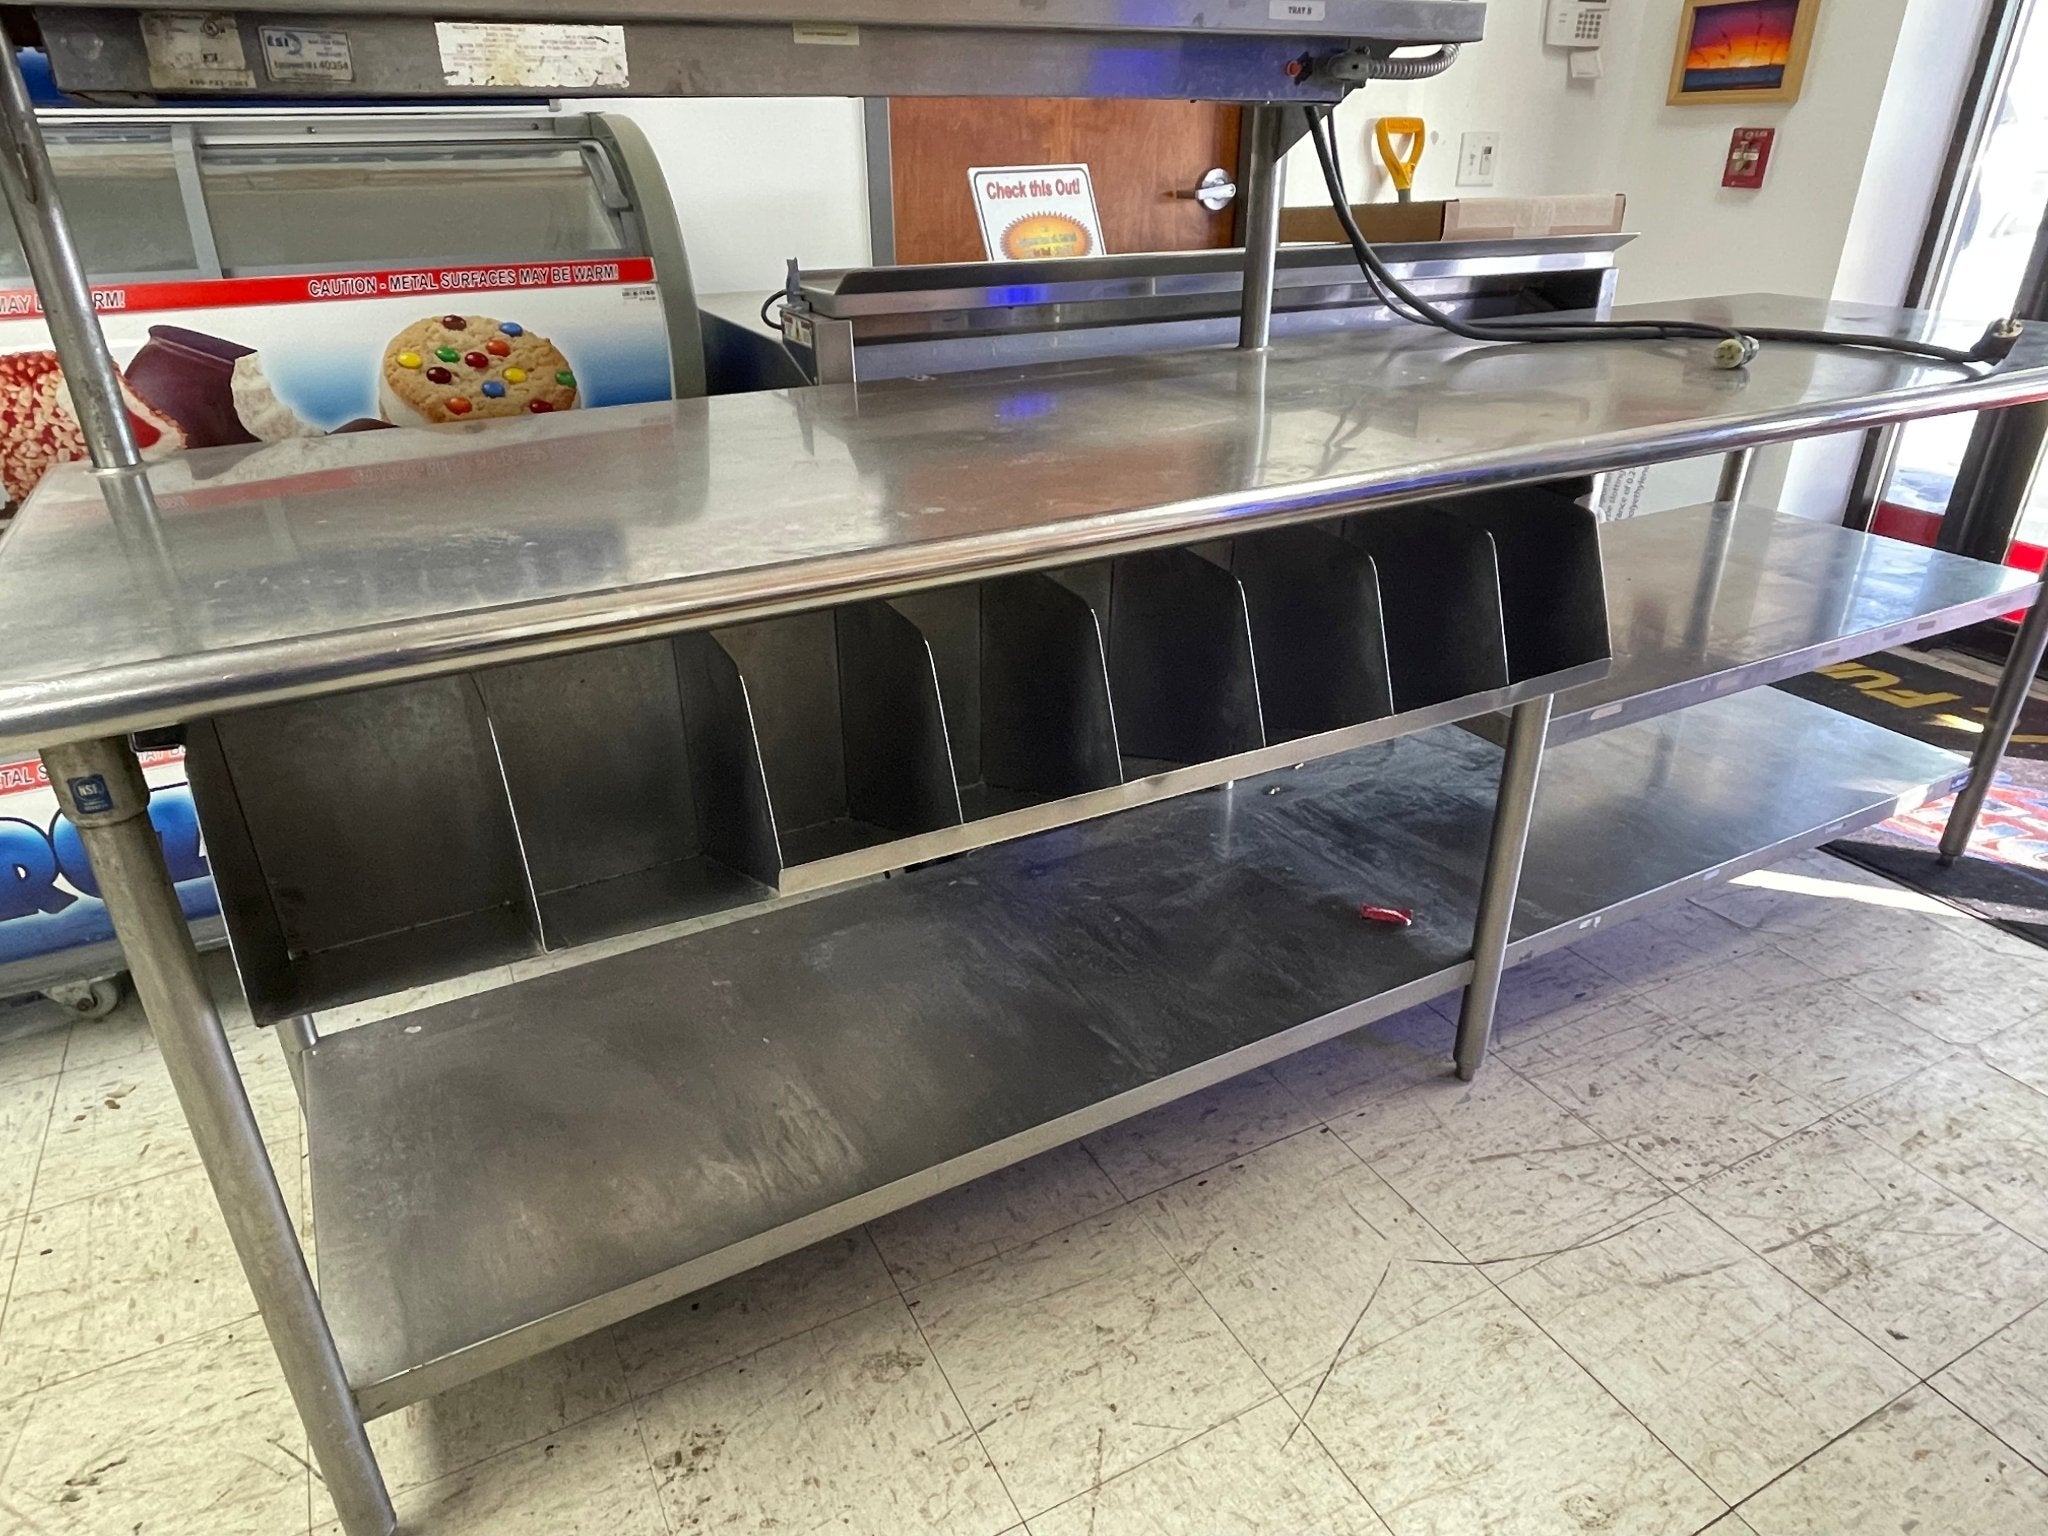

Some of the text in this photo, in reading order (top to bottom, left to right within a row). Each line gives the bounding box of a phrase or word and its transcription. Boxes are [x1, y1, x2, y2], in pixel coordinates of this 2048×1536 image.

[986, 178, 1081, 200] Check this Out!
[309, 276, 377, 297] CAUTION
[388, 273, 438, 292] METAL
[441, 269, 516, 289] SURFACES
[520, 268, 549, 285] MAY
[552, 266, 571, 282] BE
[573, 264, 619, 282] WARM!
